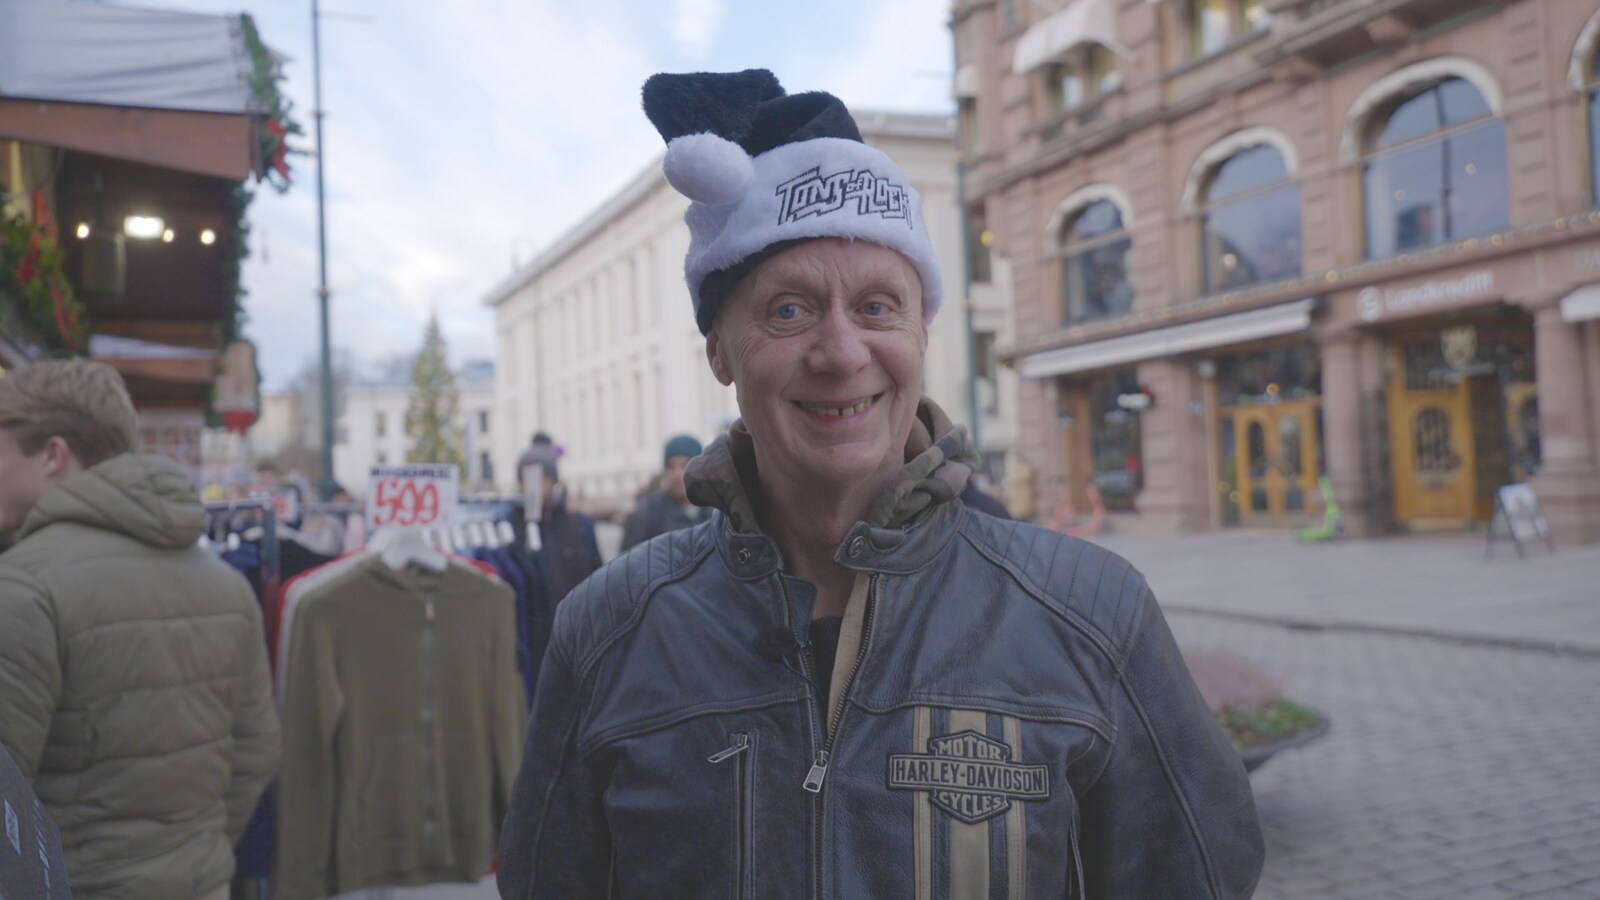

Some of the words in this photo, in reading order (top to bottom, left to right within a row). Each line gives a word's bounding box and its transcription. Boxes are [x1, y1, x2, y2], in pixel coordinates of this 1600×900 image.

[372, 479, 439, 527] 599
[936, 735, 1001, 760] MOTOR
[895, 760, 1044, 792] HARLEY-DAVIDSON
[938, 791, 1001, 817] CYCLES
